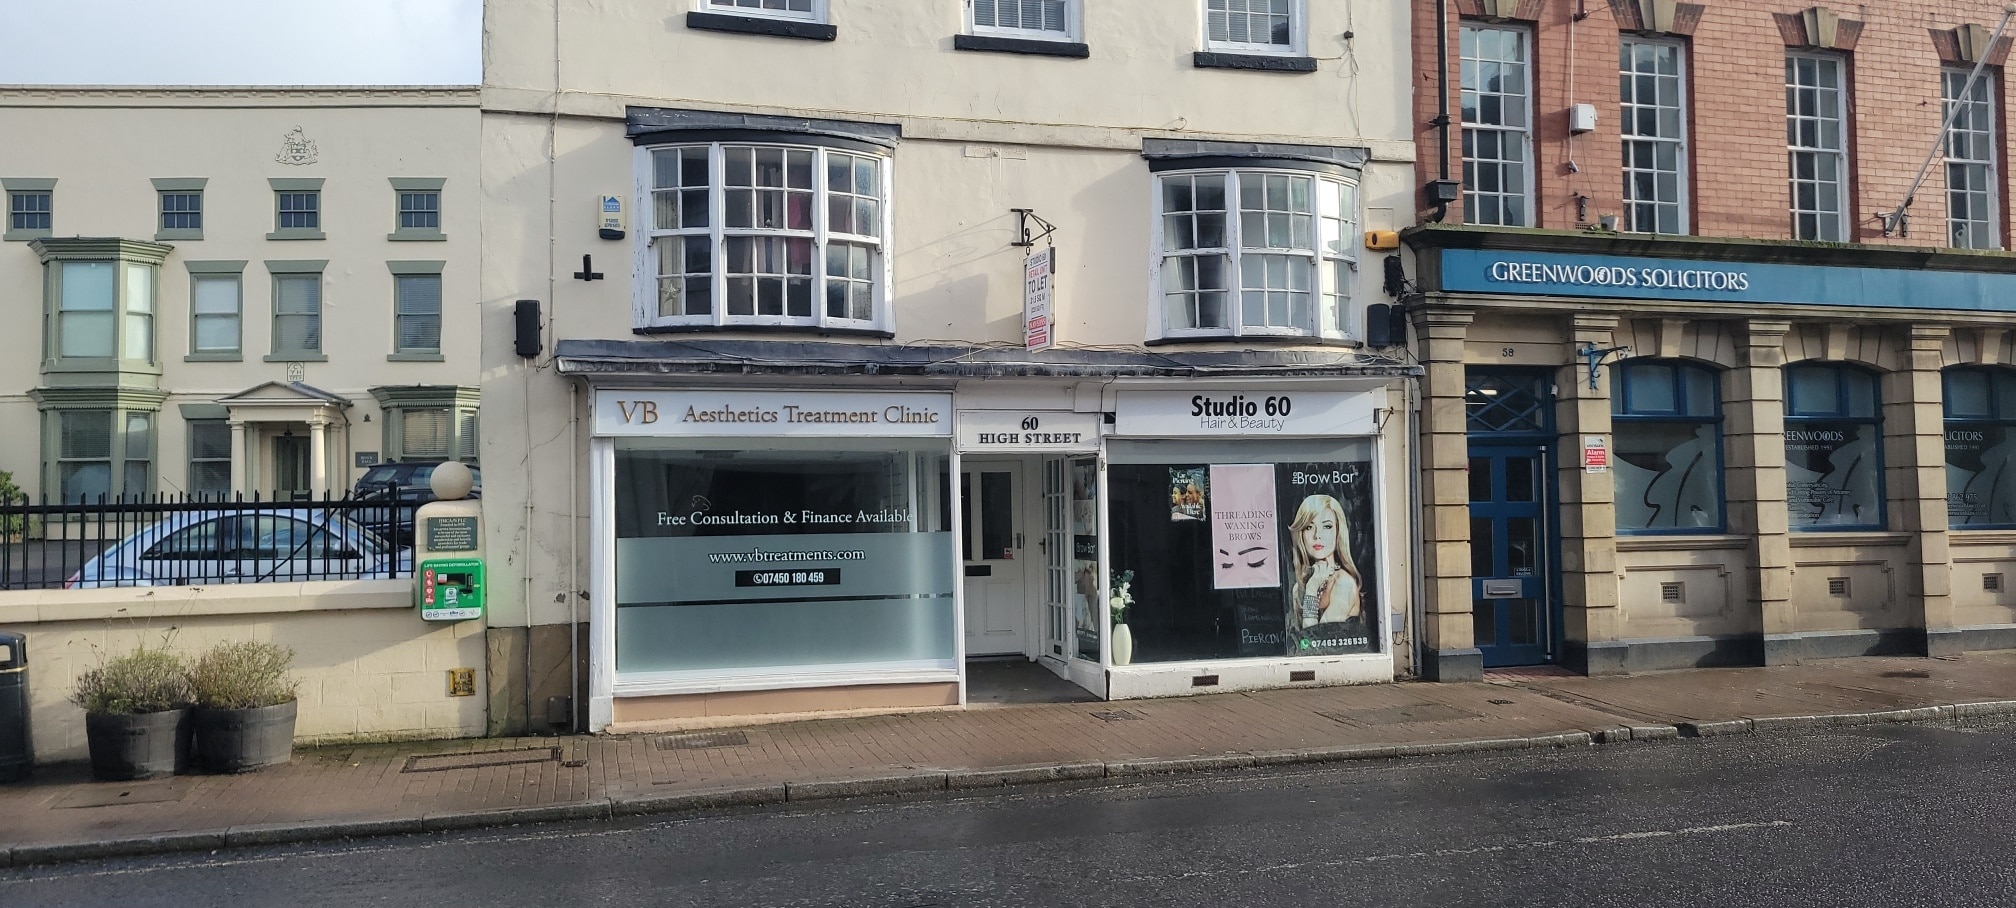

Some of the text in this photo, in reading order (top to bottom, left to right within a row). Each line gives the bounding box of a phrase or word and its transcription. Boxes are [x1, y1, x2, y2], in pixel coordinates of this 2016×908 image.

[1492, 262, 1748, 290] GREENWOODS SOLICITORS
[1028, 275, 1048, 294] TO LET
[1502, 348, 1514, 358] 58
[617, 400, 939, 424] VB Aesthetics Treatment Clinic
[1192, 395, 1291, 416] Studio 60
[1022, 417, 1038, 430] 60
[1200, 416, 1284, 431] Hair & Beauty
[979, 433, 1081, 443] HIGH STREET
[1298, 471, 1354, 484] Brow Bar
[657, 509, 913, 526] Free Consultation & Finance Available
[1215, 510, 1273, 519] THREADING
[1224, 521, 1265, 530] WAXING
[1229, 532, 1261, 540] BROWS
[709, 548, 865, 562] www.vbtreatments.com
[764, 572, 824, 584] 07450 180 459
[1242, 628, 1285, 644] PIERCING
[1312, 639, 1336, 648] 07463
